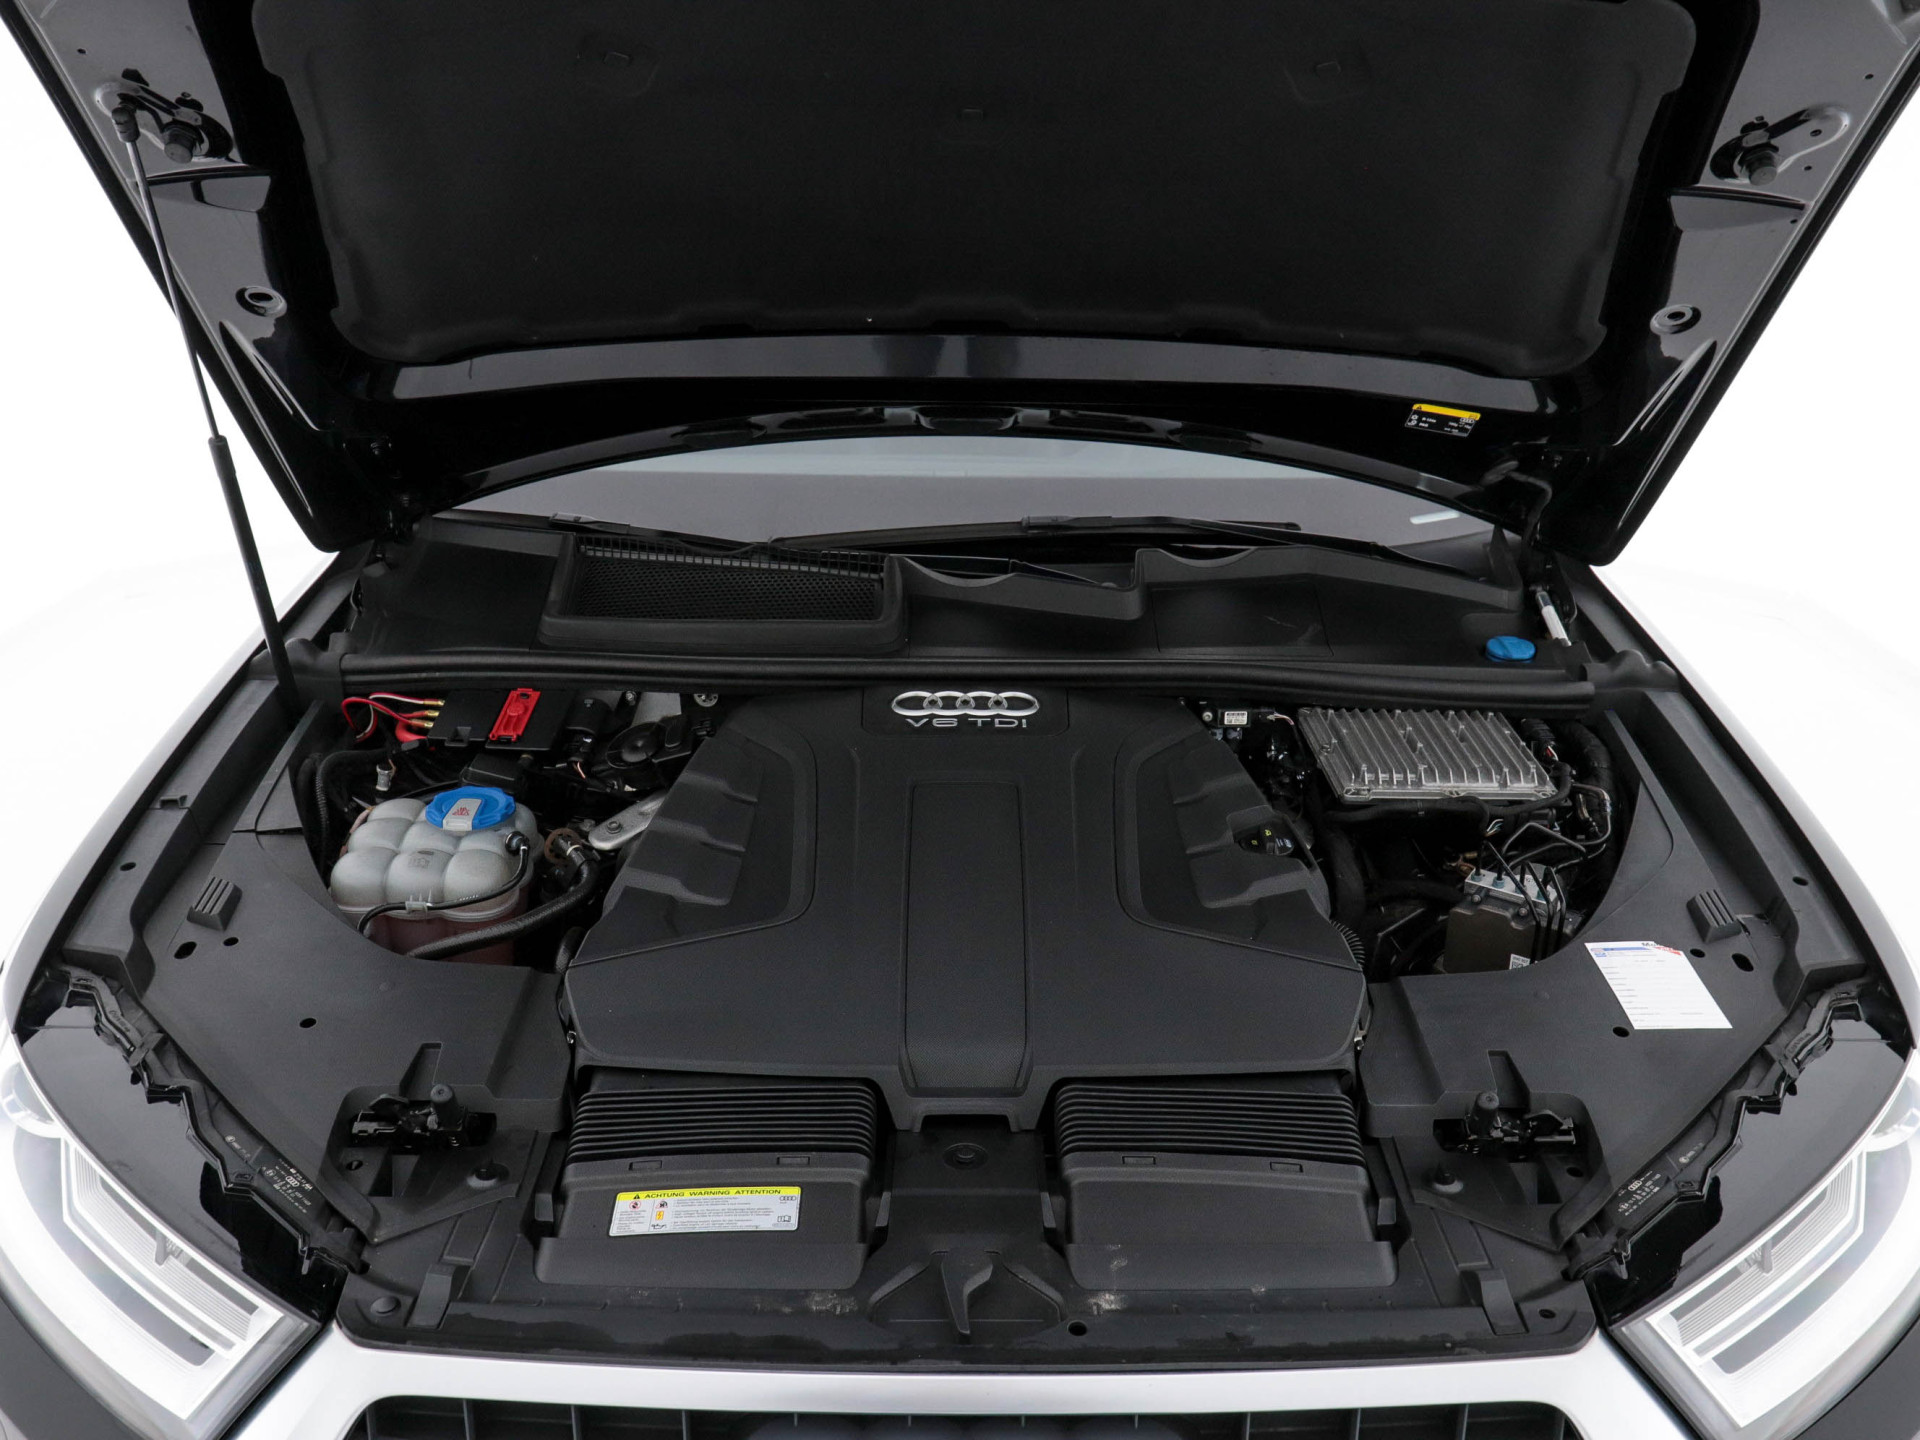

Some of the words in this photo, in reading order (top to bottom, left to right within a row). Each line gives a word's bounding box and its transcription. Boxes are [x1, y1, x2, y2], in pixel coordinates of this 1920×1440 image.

[905, 717, 958, 727] V6
[967, 717, 1027, 728] TDI
[735, 1188, 782, 1196] ATTENTION
